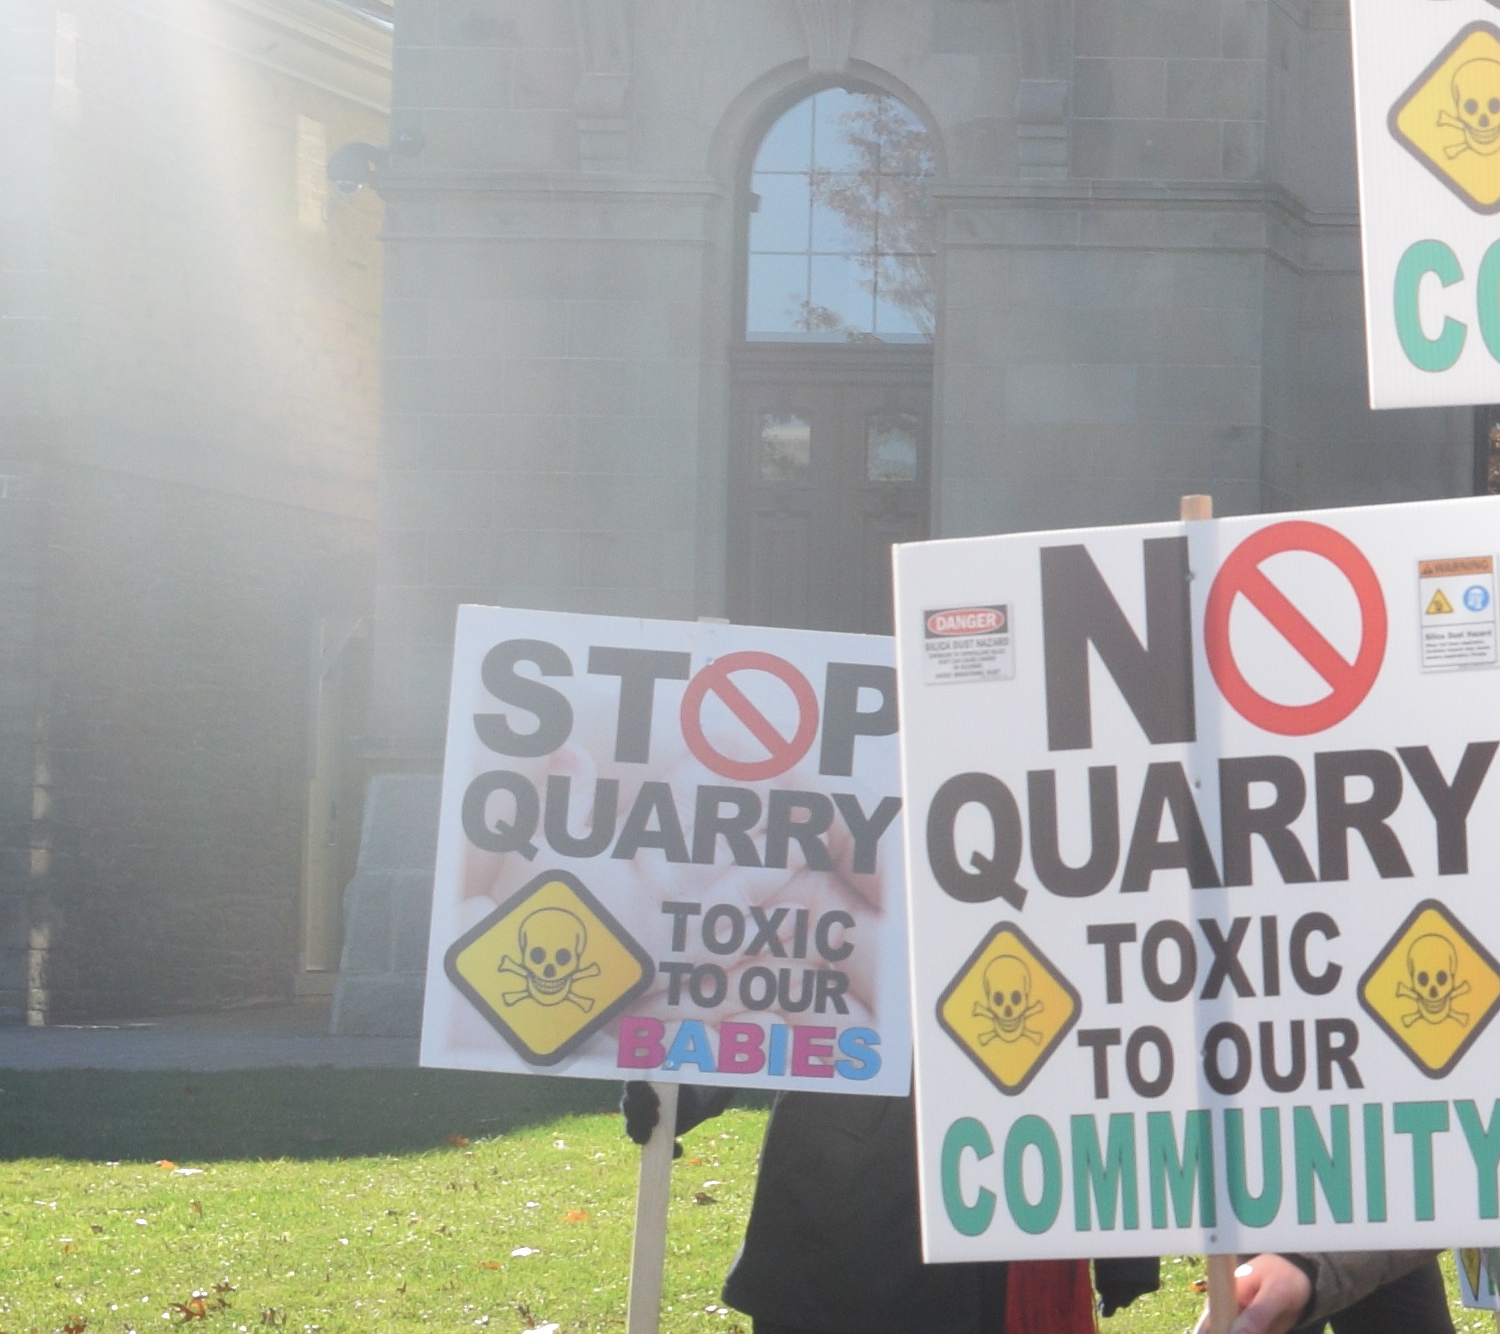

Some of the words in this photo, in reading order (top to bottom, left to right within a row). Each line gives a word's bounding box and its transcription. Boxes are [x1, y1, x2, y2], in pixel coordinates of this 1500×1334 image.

[937, 613, 996, 631] DANGER
[460, 772, 902, 876] QUARRY
[925, 740, 1500, 913] QUARRY
[661, 902, 855, 961] TOXIC
[1086, 911, 1342, 1004] TOXIC
[658, 961, 731, 1008] TO
[739, 969, 850, 1015] OUR
[616, 1016, 883, 1082] BABIES
[1077, 1027, 1174, 1100] TO
[1202, 1017, 1363, 1093] OUR
